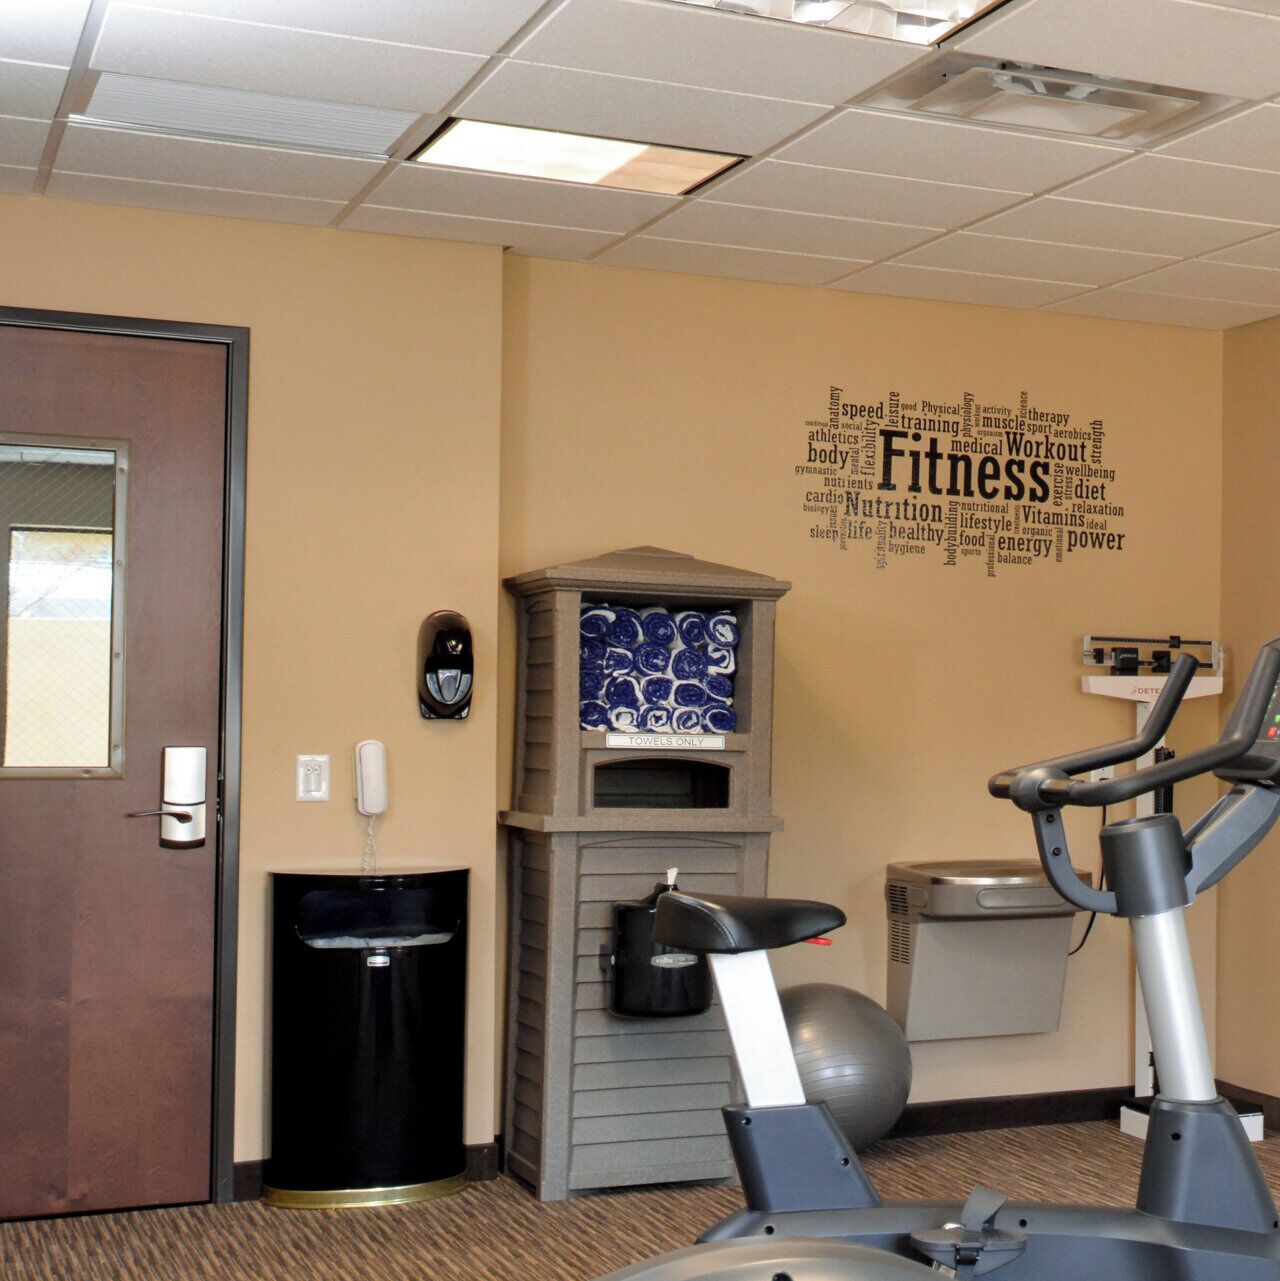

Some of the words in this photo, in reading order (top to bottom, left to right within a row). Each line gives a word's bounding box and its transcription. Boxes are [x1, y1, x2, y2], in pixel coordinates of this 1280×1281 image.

[828, 385, 843, 430] anatomy
[842, 402, 884, 420] speed
[885, 391, 900, 429] leisure
[921, 400, 960, 415] Physical
[982, 405, 1012, 417] activity
[1017, 390, 1028, 419] science
[960, 391, 975, 438] physiology
[982, 415, 1026, 431] muscle
[1028, 408, 1070, 427] therapy
[901, 413, 960, 437] training
[1027, 423, 1052, 435] sport
[1053, 428, 1093, 440] aerobics
[808, 428, 860, 445] athletics
[1089, 419, 1105, 464] strength
[807, 442, 850, 470] body
[860, 419, 880, 476] flexibility
[951, 437, 1003, 456] medical
[1005, 431, 1087, 462] Workout
[794, 465, 838, 476] gymnastic
[877, 429, 1050, 503] Fitness
[1065, 464, 1116, 482] wellbeing
[824, 475, 874, 490] nutrients
[1050, 462, 1064, 507] exercise
[1074, 479, 1106, 501] diet
[806, 488, 844, 504] cardio
[843, 490, 943, 523] Nutrition
[961, 501, 1009, 514] nutritional
[1022, 505, 1085, 527] Vitamins
[1072, 500, 1125, 517] relaxation
[848, 520, 873, 539] life
[960, 513, 1012, 533] lifestyle
[1022, 525, 1053, 537] organic
[1086, 518, 1107, 530] ideal
[810, 525, 839, 542] sleep
[889, 521, 944, 545] healthy
[943, 500, 961, 566] bodybuilding
[960, 530, 985, 547] food
[1067, 530, 1125, 552] power
[888, 541, 926, 556] hygiene
[997, 536, 1053, 558] energy
[997, 552, 1033, 565] balance
[628, 736, 673, 746] TOWELS
[676, 737, 704, 746] ONLY
